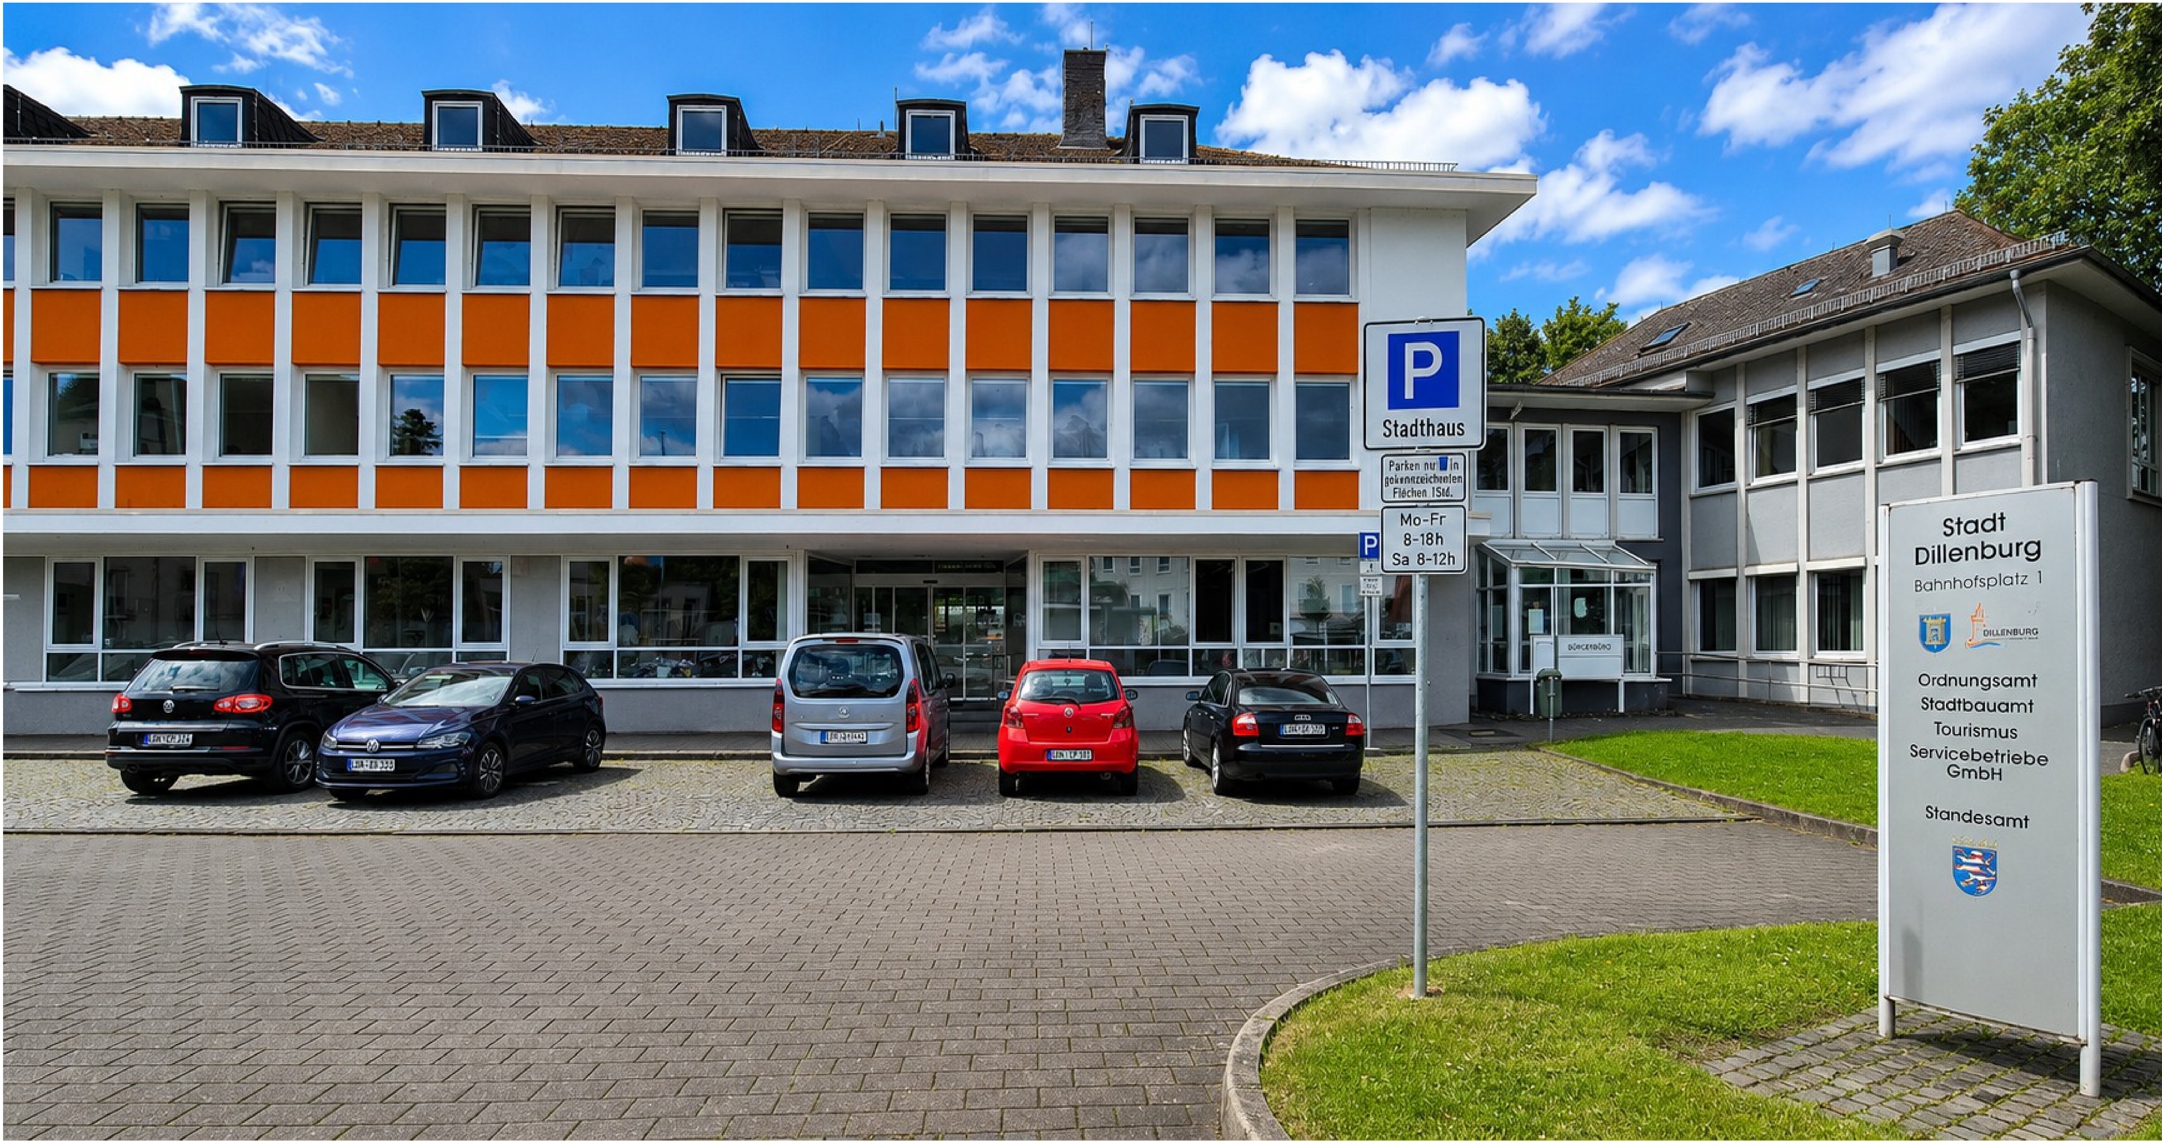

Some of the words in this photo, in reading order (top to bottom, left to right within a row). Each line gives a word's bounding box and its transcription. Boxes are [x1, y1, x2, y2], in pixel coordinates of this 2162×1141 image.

[1404, 341, 1443, 400] P
[1382, 417, 1465, 438] Stadthaus
[1389, 460, 1420, 472] Parken
[1400, 512, 1447, 527] Mo-Fr
[1943, 511, 2006, 537] Stadt
[1364, 535, 1378, 556] P
[1403, 532, 1444, 547] 8-18h
[1392, 552, 1410, 566] Sa
[1417, 551, 1456, 566] 8-12h
[1915, 540, 2041, 566] Dillenburg
[1914, 573, 2029, 593] Bahnhofsplatz
[2037, 570, 2042, 584] 1
[1983, 627, 2039, 637] DILLENBURG
[1918, 673, 2038, 691] Ordnungsamt
[1920, 697, 2035, 714] Stadtbauamt
[1934, 721, 2018, 739] Tourismus
[1909, 744, 2049, 767] Servicebetriebe
[1946, 763, 2003, 781] GmbH
[1925, 805, 2030, 829] Standesamt
